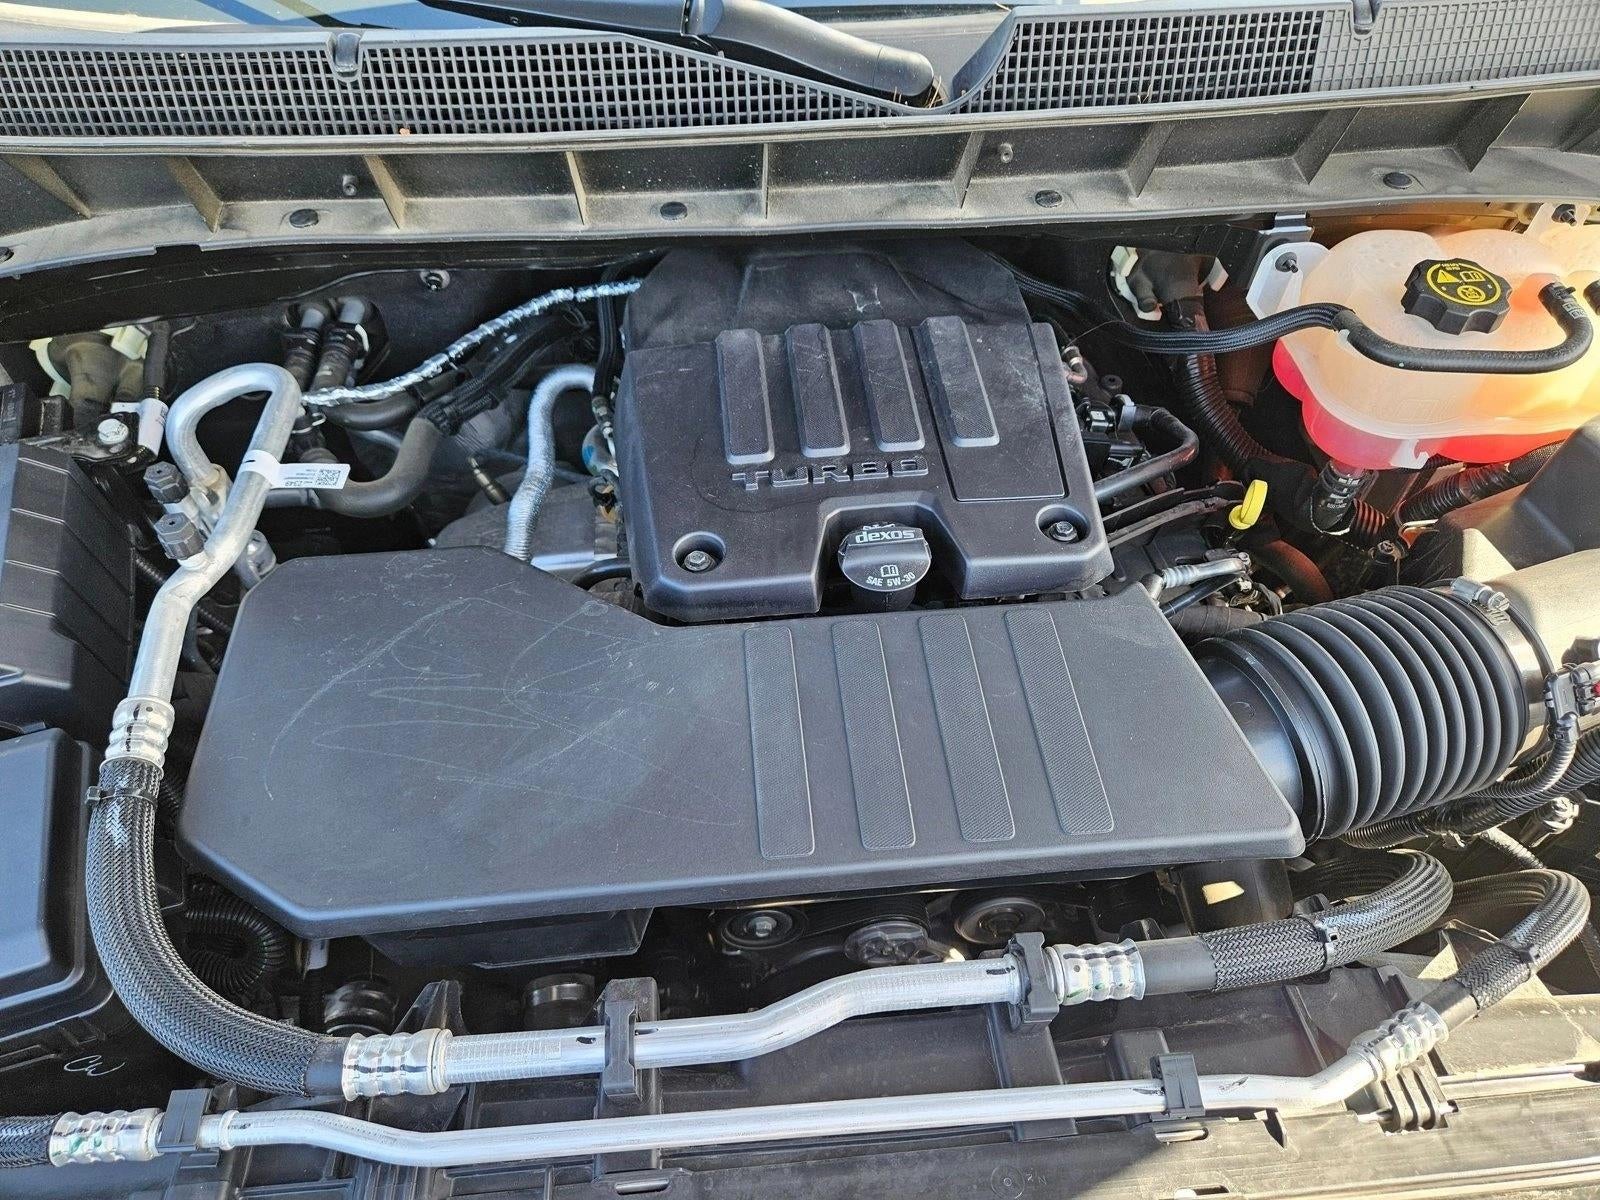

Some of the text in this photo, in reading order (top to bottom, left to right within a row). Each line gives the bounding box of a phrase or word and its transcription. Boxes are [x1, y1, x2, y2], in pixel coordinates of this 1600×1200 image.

[732, 456, 929, 490] TURBO
[855, 529, 915, 544] dexos
[866, 571, 916, 587] SAE 5W-30
